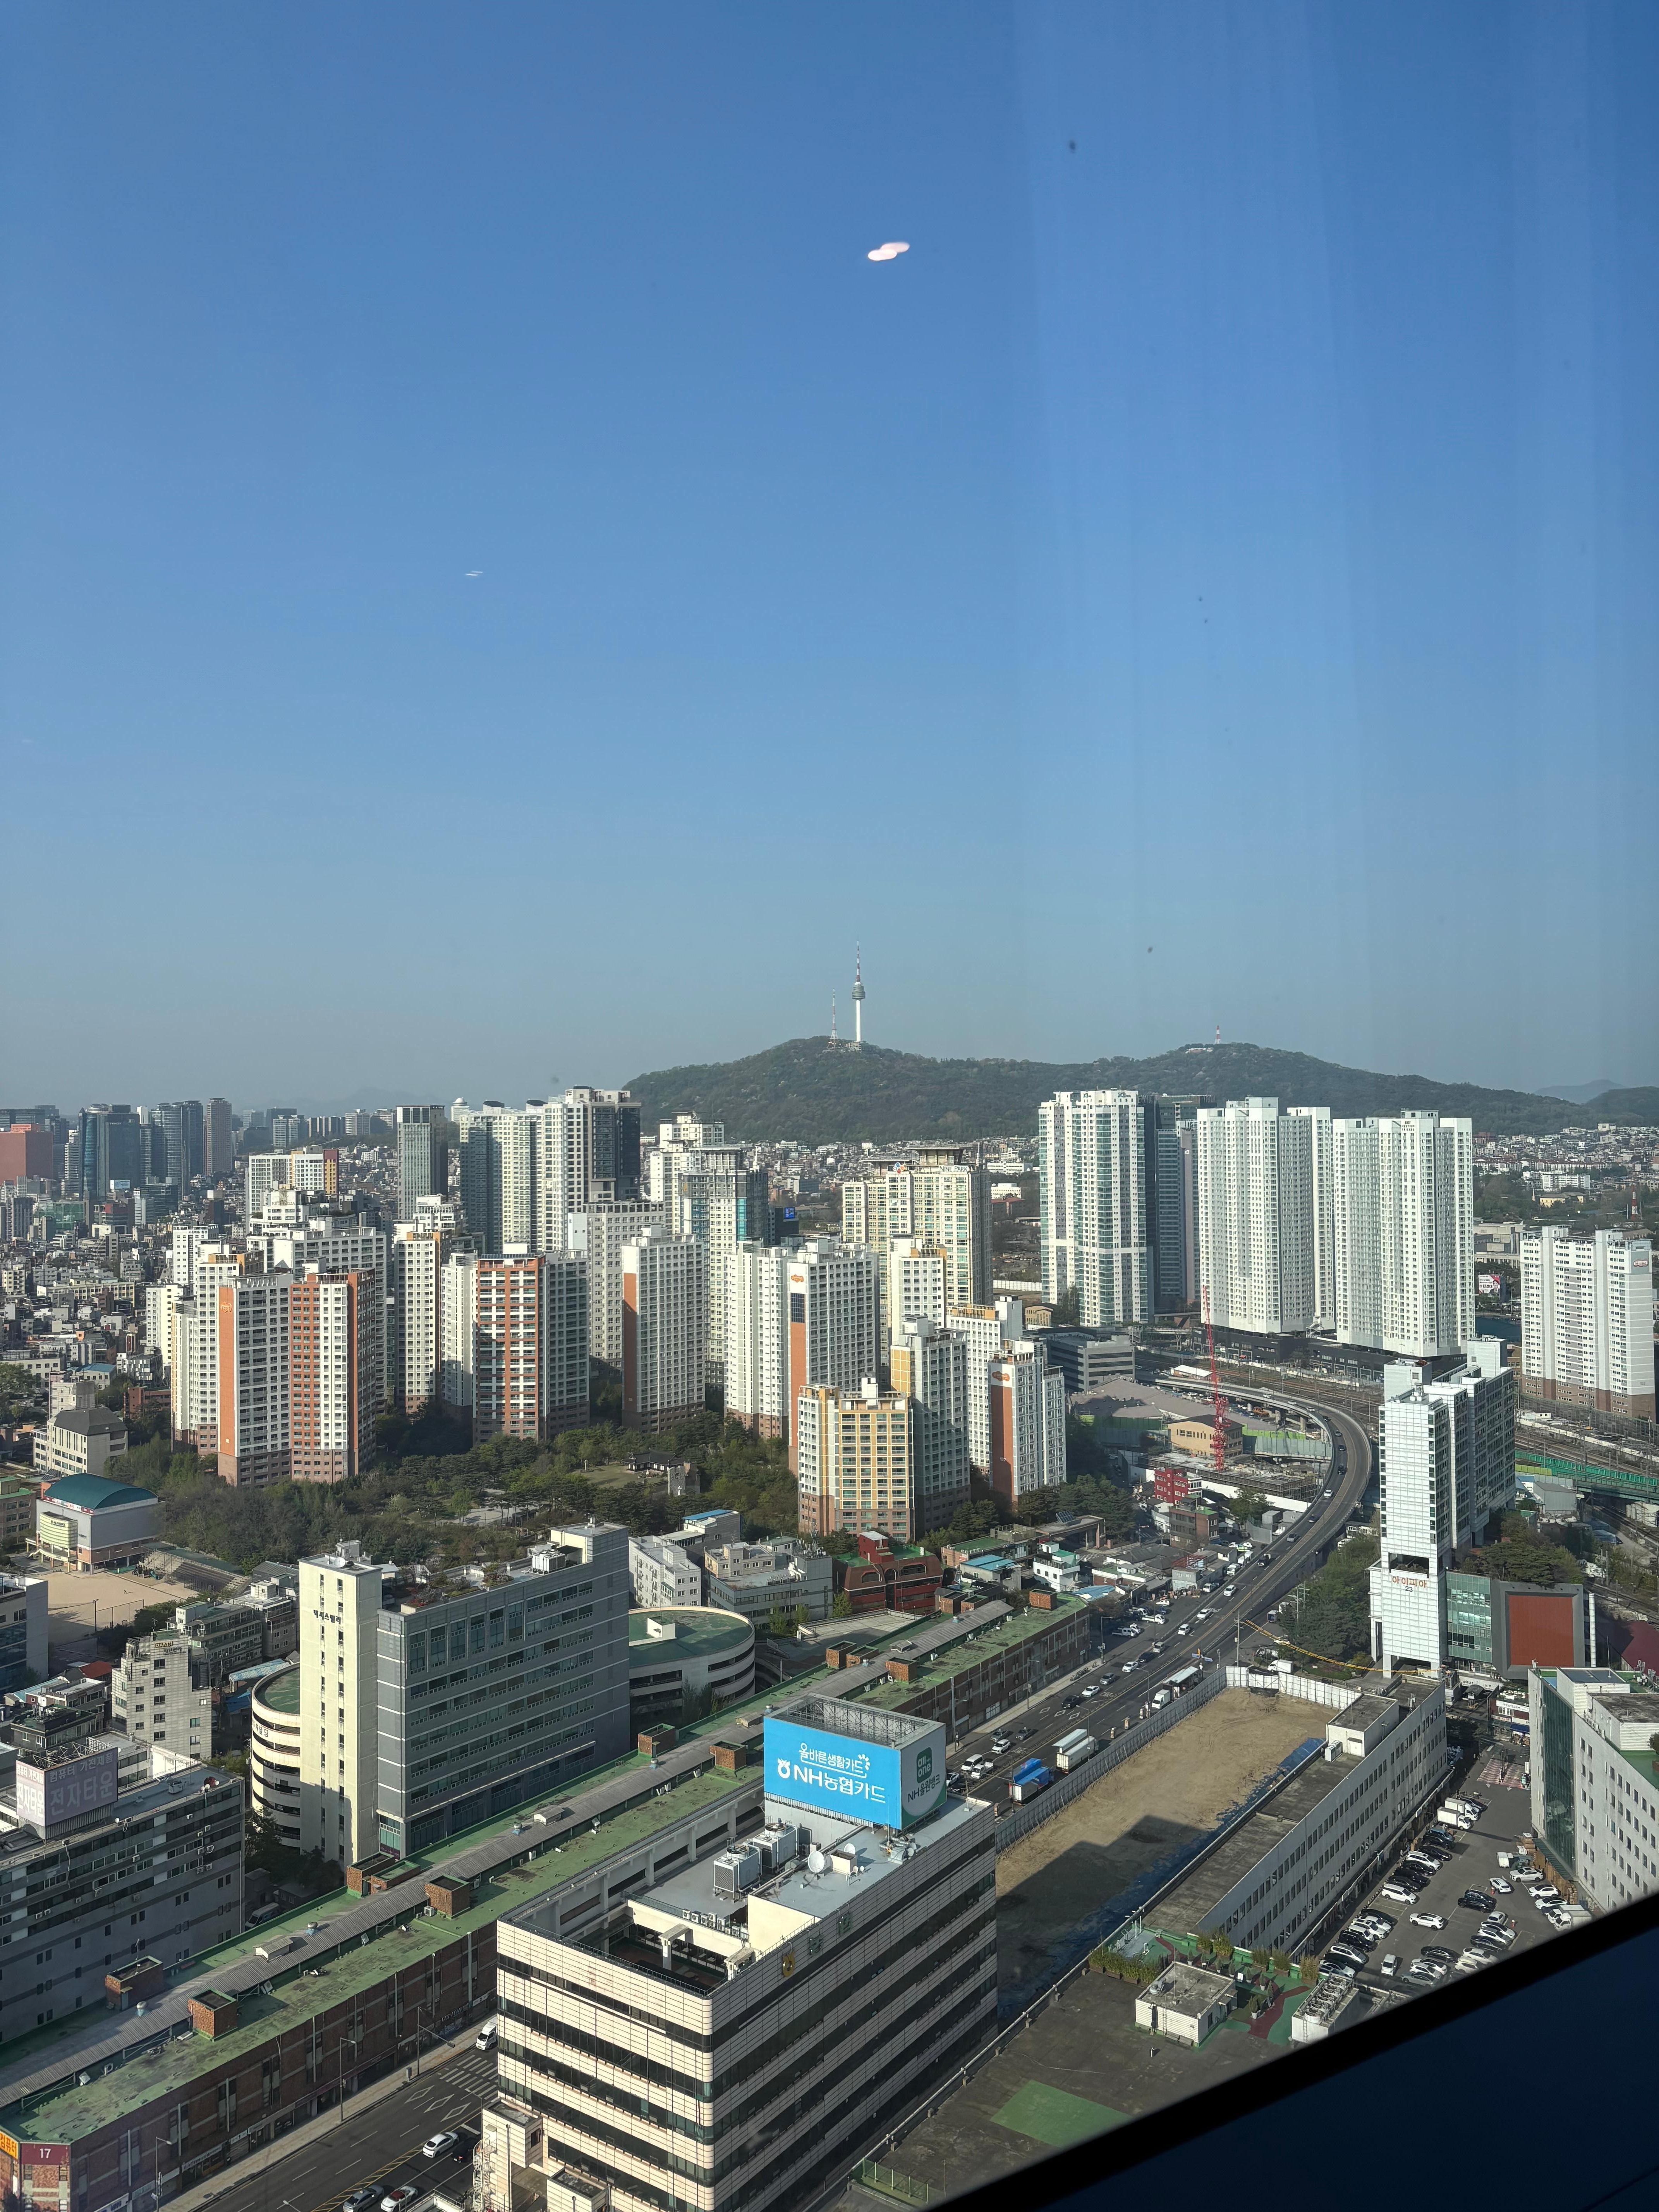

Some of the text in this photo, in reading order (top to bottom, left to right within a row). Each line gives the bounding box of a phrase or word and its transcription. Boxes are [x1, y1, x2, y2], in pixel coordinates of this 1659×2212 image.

[1393, 1576, 1427, 1588] 아이피아
[17, 1764, 28, 1778] 컴퓨터
[50, 1752, 113, 1783] 컴퓨터 가전제품
[918, 1755, 926, 1768] all
[918, 1763, 931, 1778] one
[50, 1770, 113, 1816] 전자타운
[908, 1774, 940, 1803] NH올원뱅크
[17, 1782, 44, 1818] 전자타운
[0, 2133, 17, 2157] 컴퓨터
[40, 2148, 51, 2159] 17
